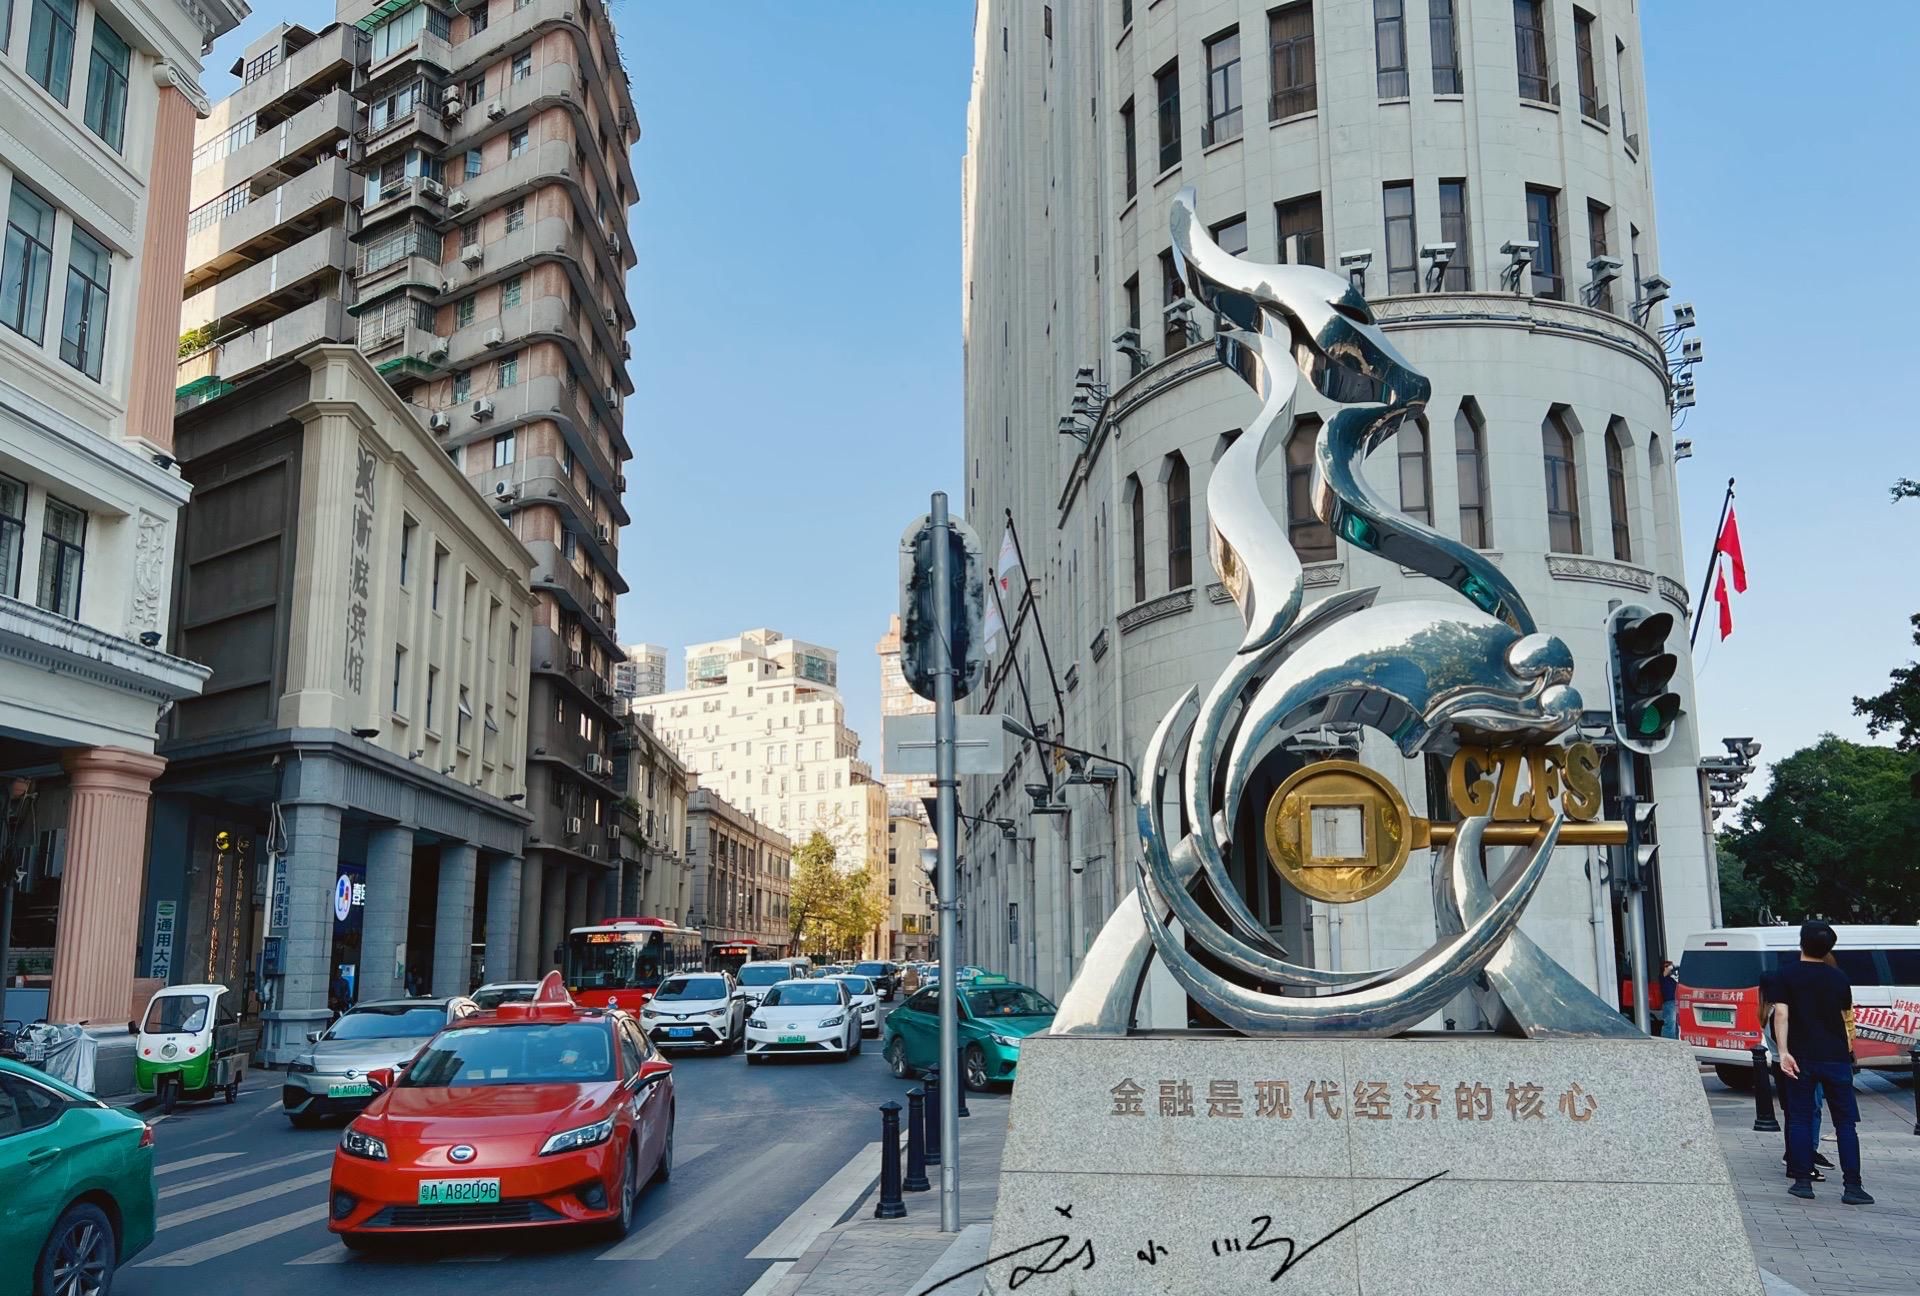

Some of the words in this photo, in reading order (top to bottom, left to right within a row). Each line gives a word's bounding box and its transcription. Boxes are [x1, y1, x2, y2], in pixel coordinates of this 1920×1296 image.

[1447, 742, 1602, 822] GZFS
[152, 918, 173, 984] 通用大药
[1109, 1077, 1599, 1122] 金融是现代经济的核心
